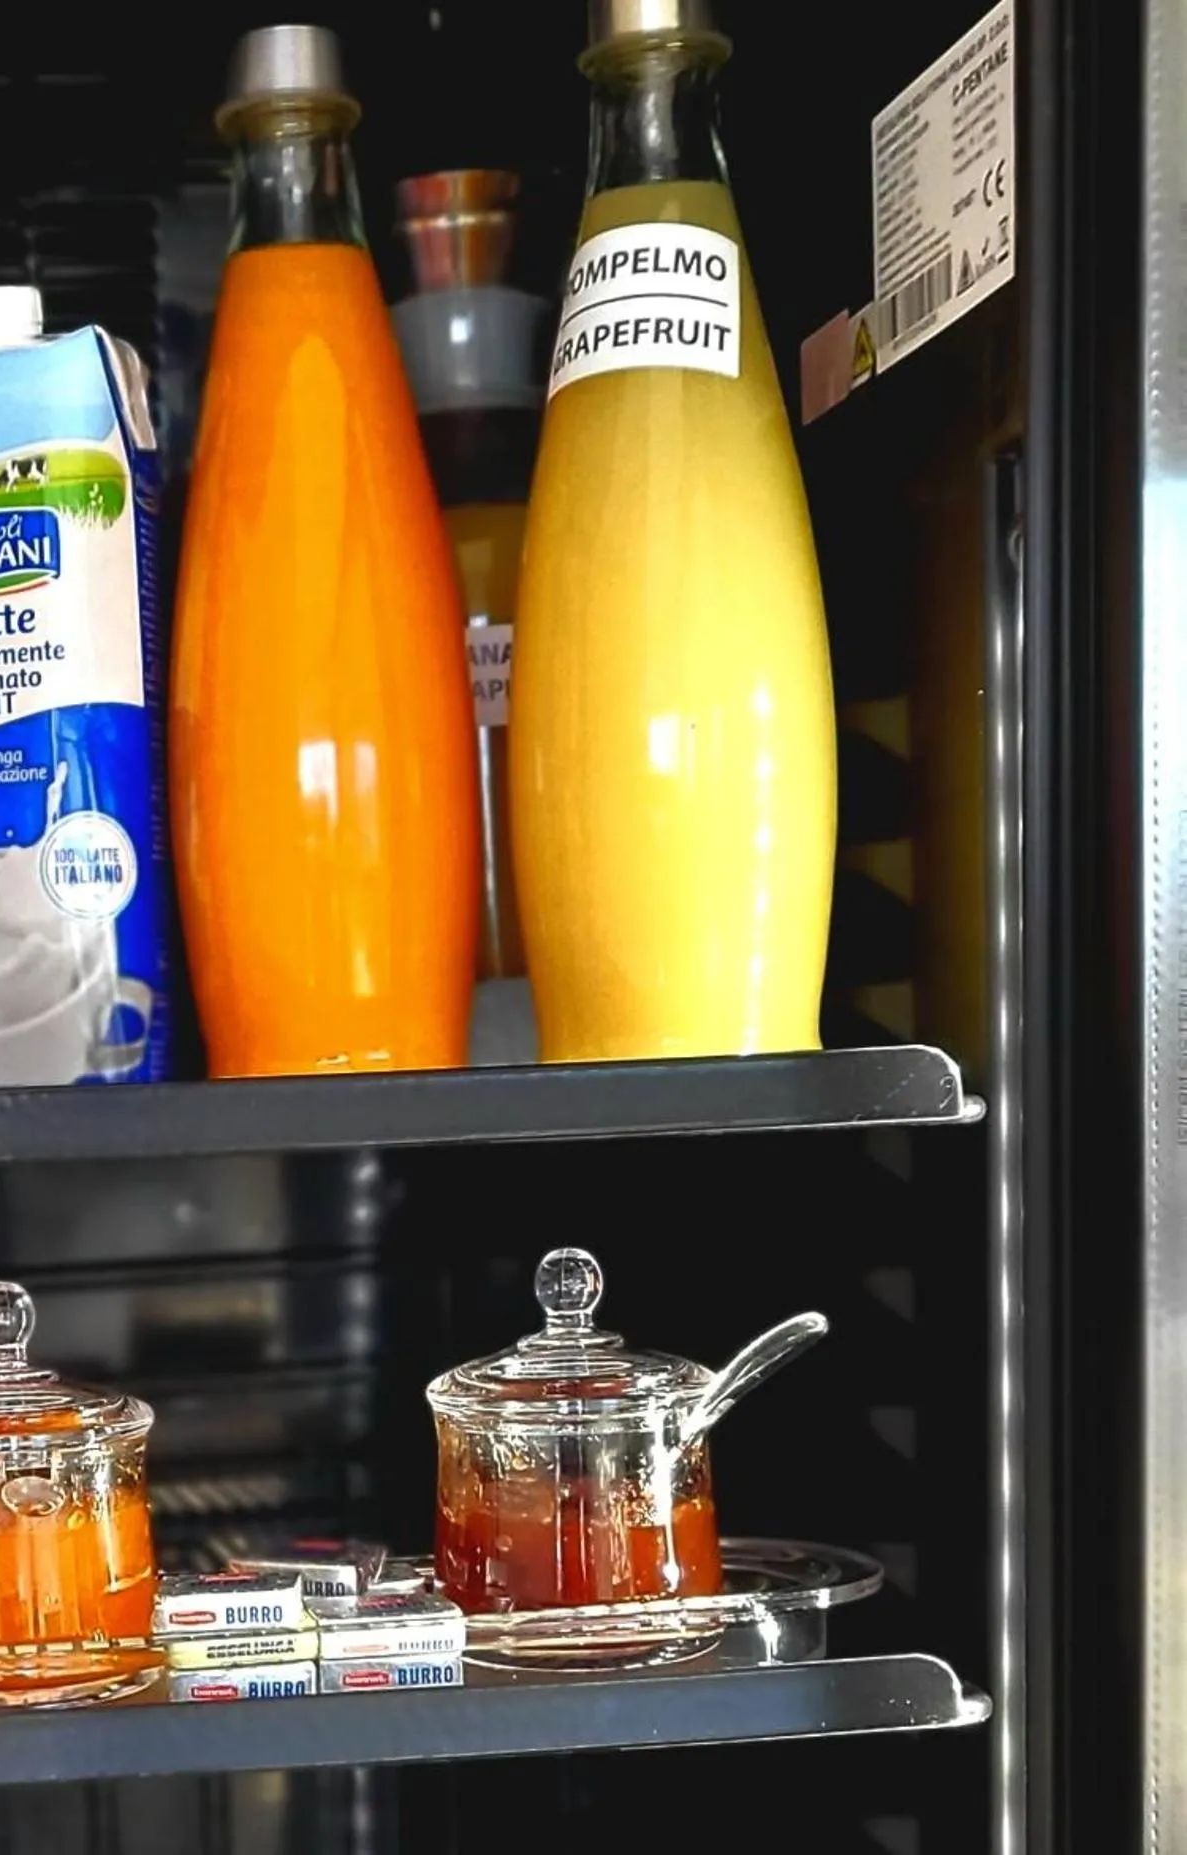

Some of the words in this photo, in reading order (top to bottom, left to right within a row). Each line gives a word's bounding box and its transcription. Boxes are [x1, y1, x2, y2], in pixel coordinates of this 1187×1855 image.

[570, 246, 727, 297] OMPELMO
[54, 864, 123, 885] ITALIANO
[302, 1580, 346, 1597] URRO
[225, 1605, 283, 1625] BURRO
[397, 1665, 455, 1685] BURRO
[248, 1681, 306, 1698] BURRO
